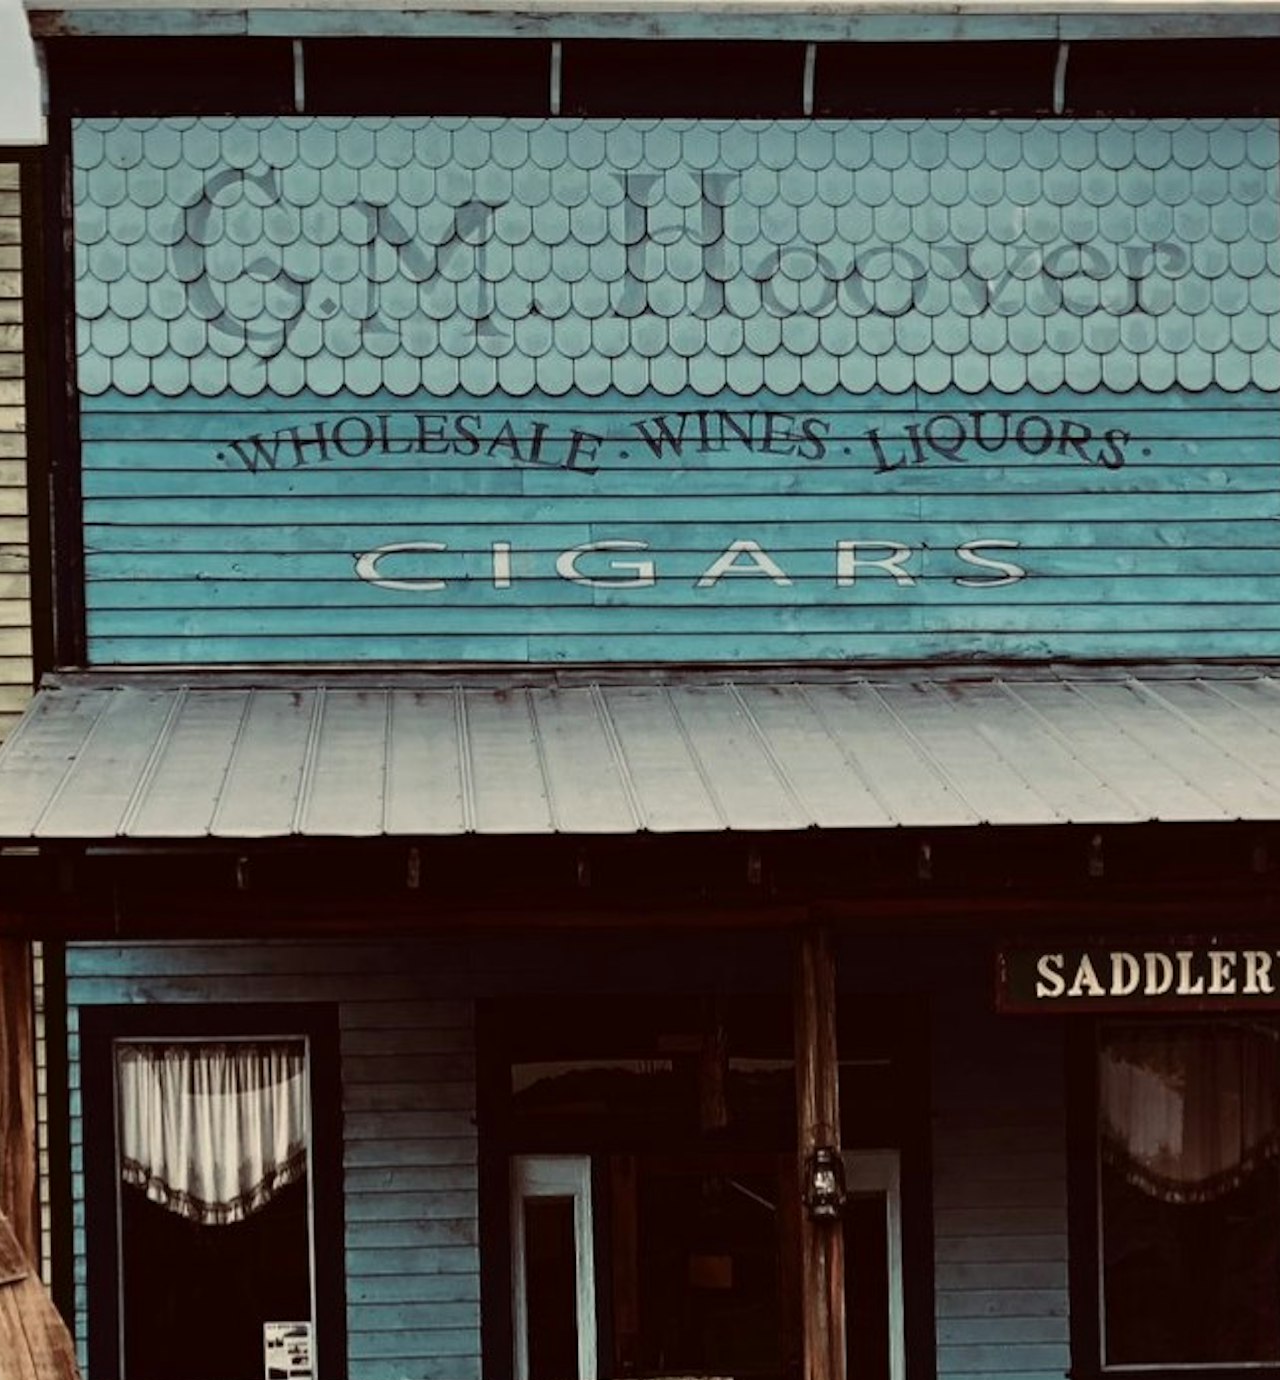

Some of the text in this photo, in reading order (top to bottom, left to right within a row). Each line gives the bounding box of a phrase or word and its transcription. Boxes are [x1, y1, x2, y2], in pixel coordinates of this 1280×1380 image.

[608, 172, 1188, 317] Hoover
[228, 413, 603, 475] WHOLESALE
[354, 538, 1028, 590] CIGARS
